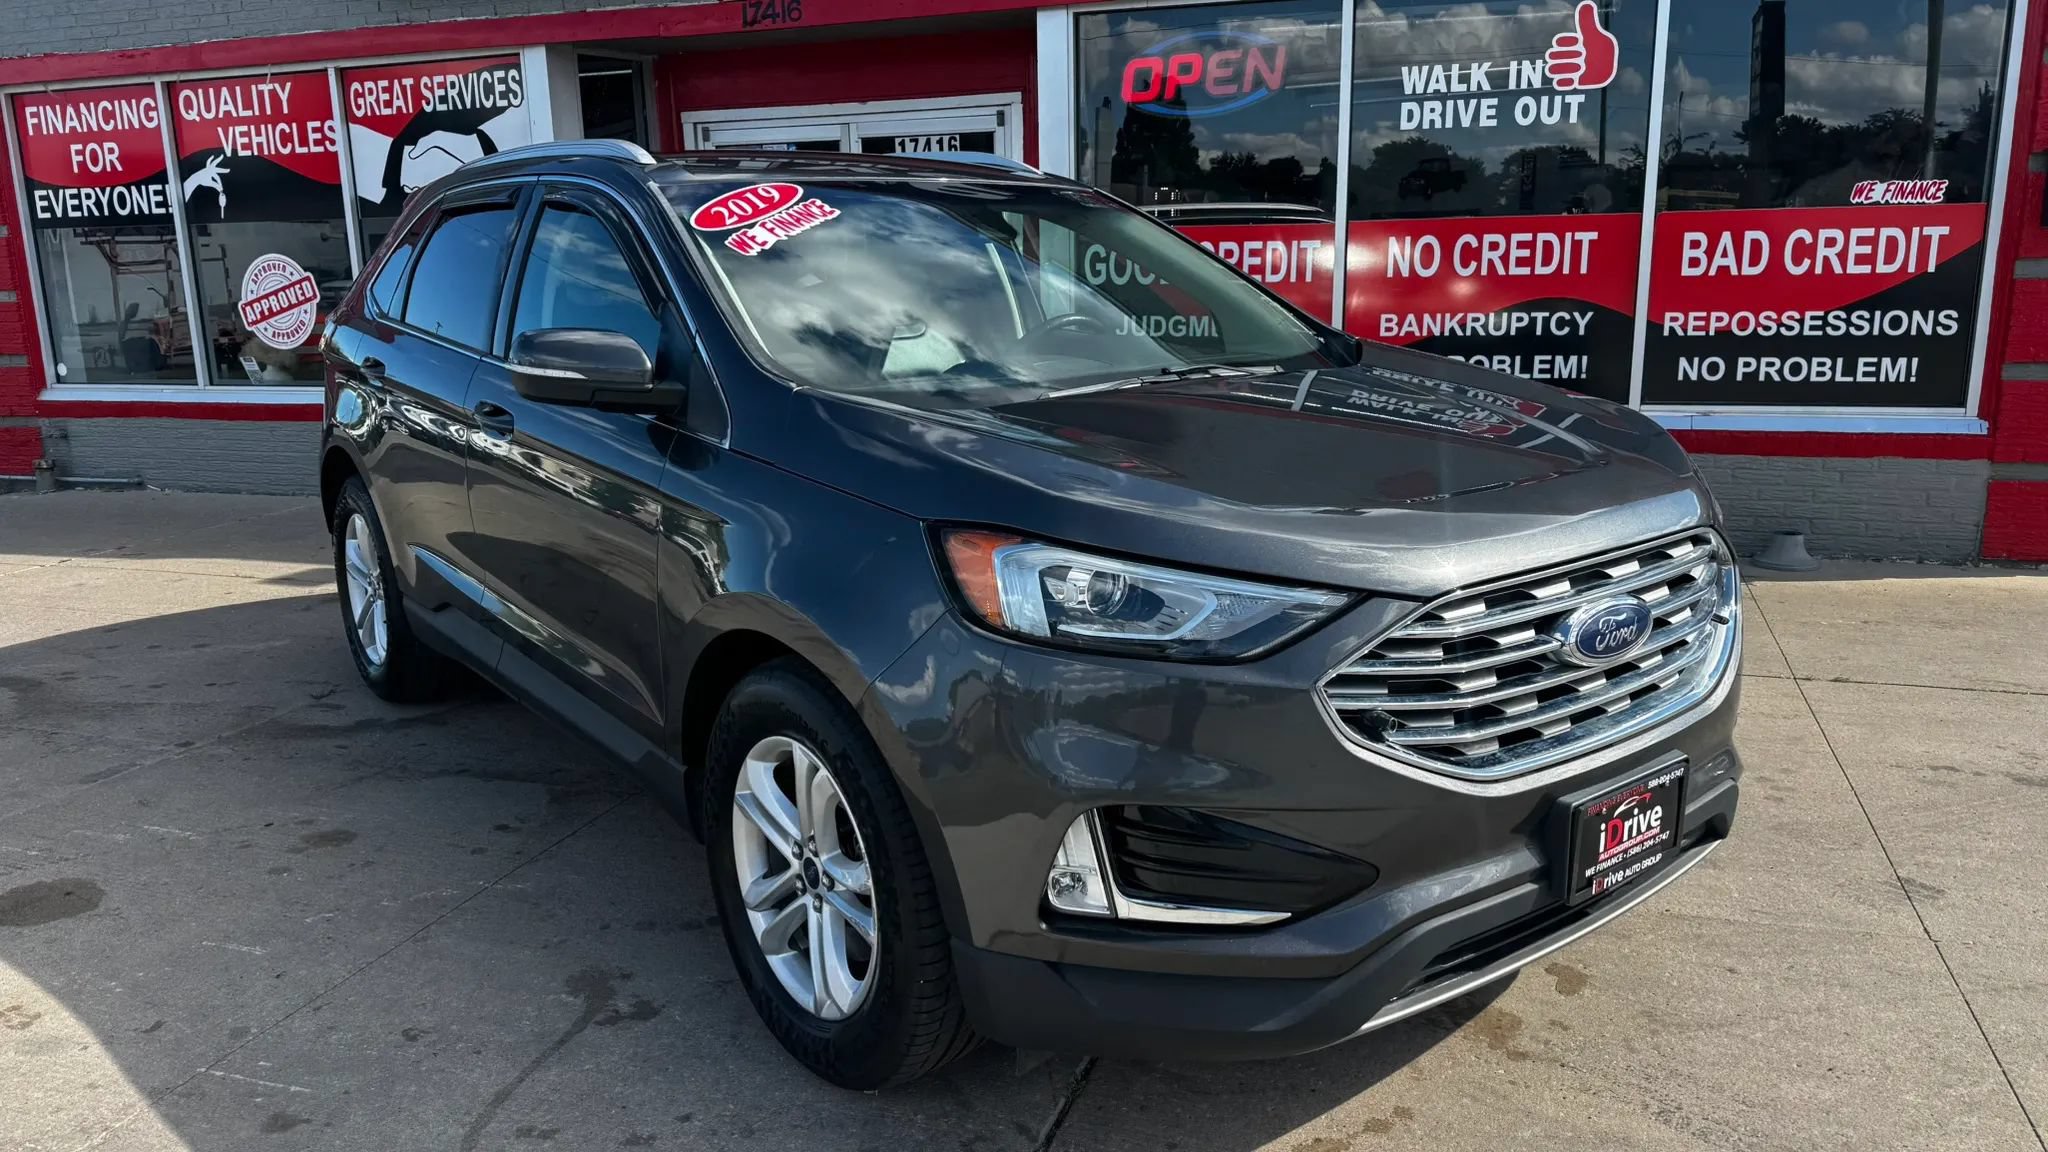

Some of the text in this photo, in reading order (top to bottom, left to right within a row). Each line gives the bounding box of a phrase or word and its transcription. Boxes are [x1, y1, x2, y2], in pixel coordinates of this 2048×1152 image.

[743, 0, 802, 28] 17416
[1121, 45, 1287, 103] OPEN
[1401, 60, 1544, 95] WALK IN
[178, 82, 291, 122] QUALITY
[350, 69, 522, 118] GREAT SERVICES
[25, 98, 159, 136] FINANCING
[1400, 95, 1586, 131] DRIVE OUT
[217, 119, 338, 157] VEHICLES
[70, 142, 123, 174] FOR
[34, 184, 174, 219] EVERYONE!
[711, 186, 781, 226] 2019
[1852, 181, 1948, 201] WE FINANCE
[727, 200, 835, 255] WE FINANCE
[1386, 232, 1599, 278] NO CREDIT
[1681, 226, 1950, 276] BAD CREDIT
[251, 263, 288, 285] APPROVED
[245, 280, 314, 323] APPROVED
[271, 319, 306, 341] APPROVED
[1379, 311, 1595, 337] BANKRUPTCY
[1663, 309, 1959, 336] REPOSSESSIONS
[1677, 356, 1920, 382] NO PROBLEM!
[1596, 613, 1638, 651] Ford
[1599, 805, 1663, 853] iDrive
[1599, 826, 1661, 862] AUTOGROUP.COM
[1585, 866, 1597, 878] WE
[1596, 852, 1624, 873] FINANCE
[1592, 853, 1663, 895] iDrive AUTO GROUP
